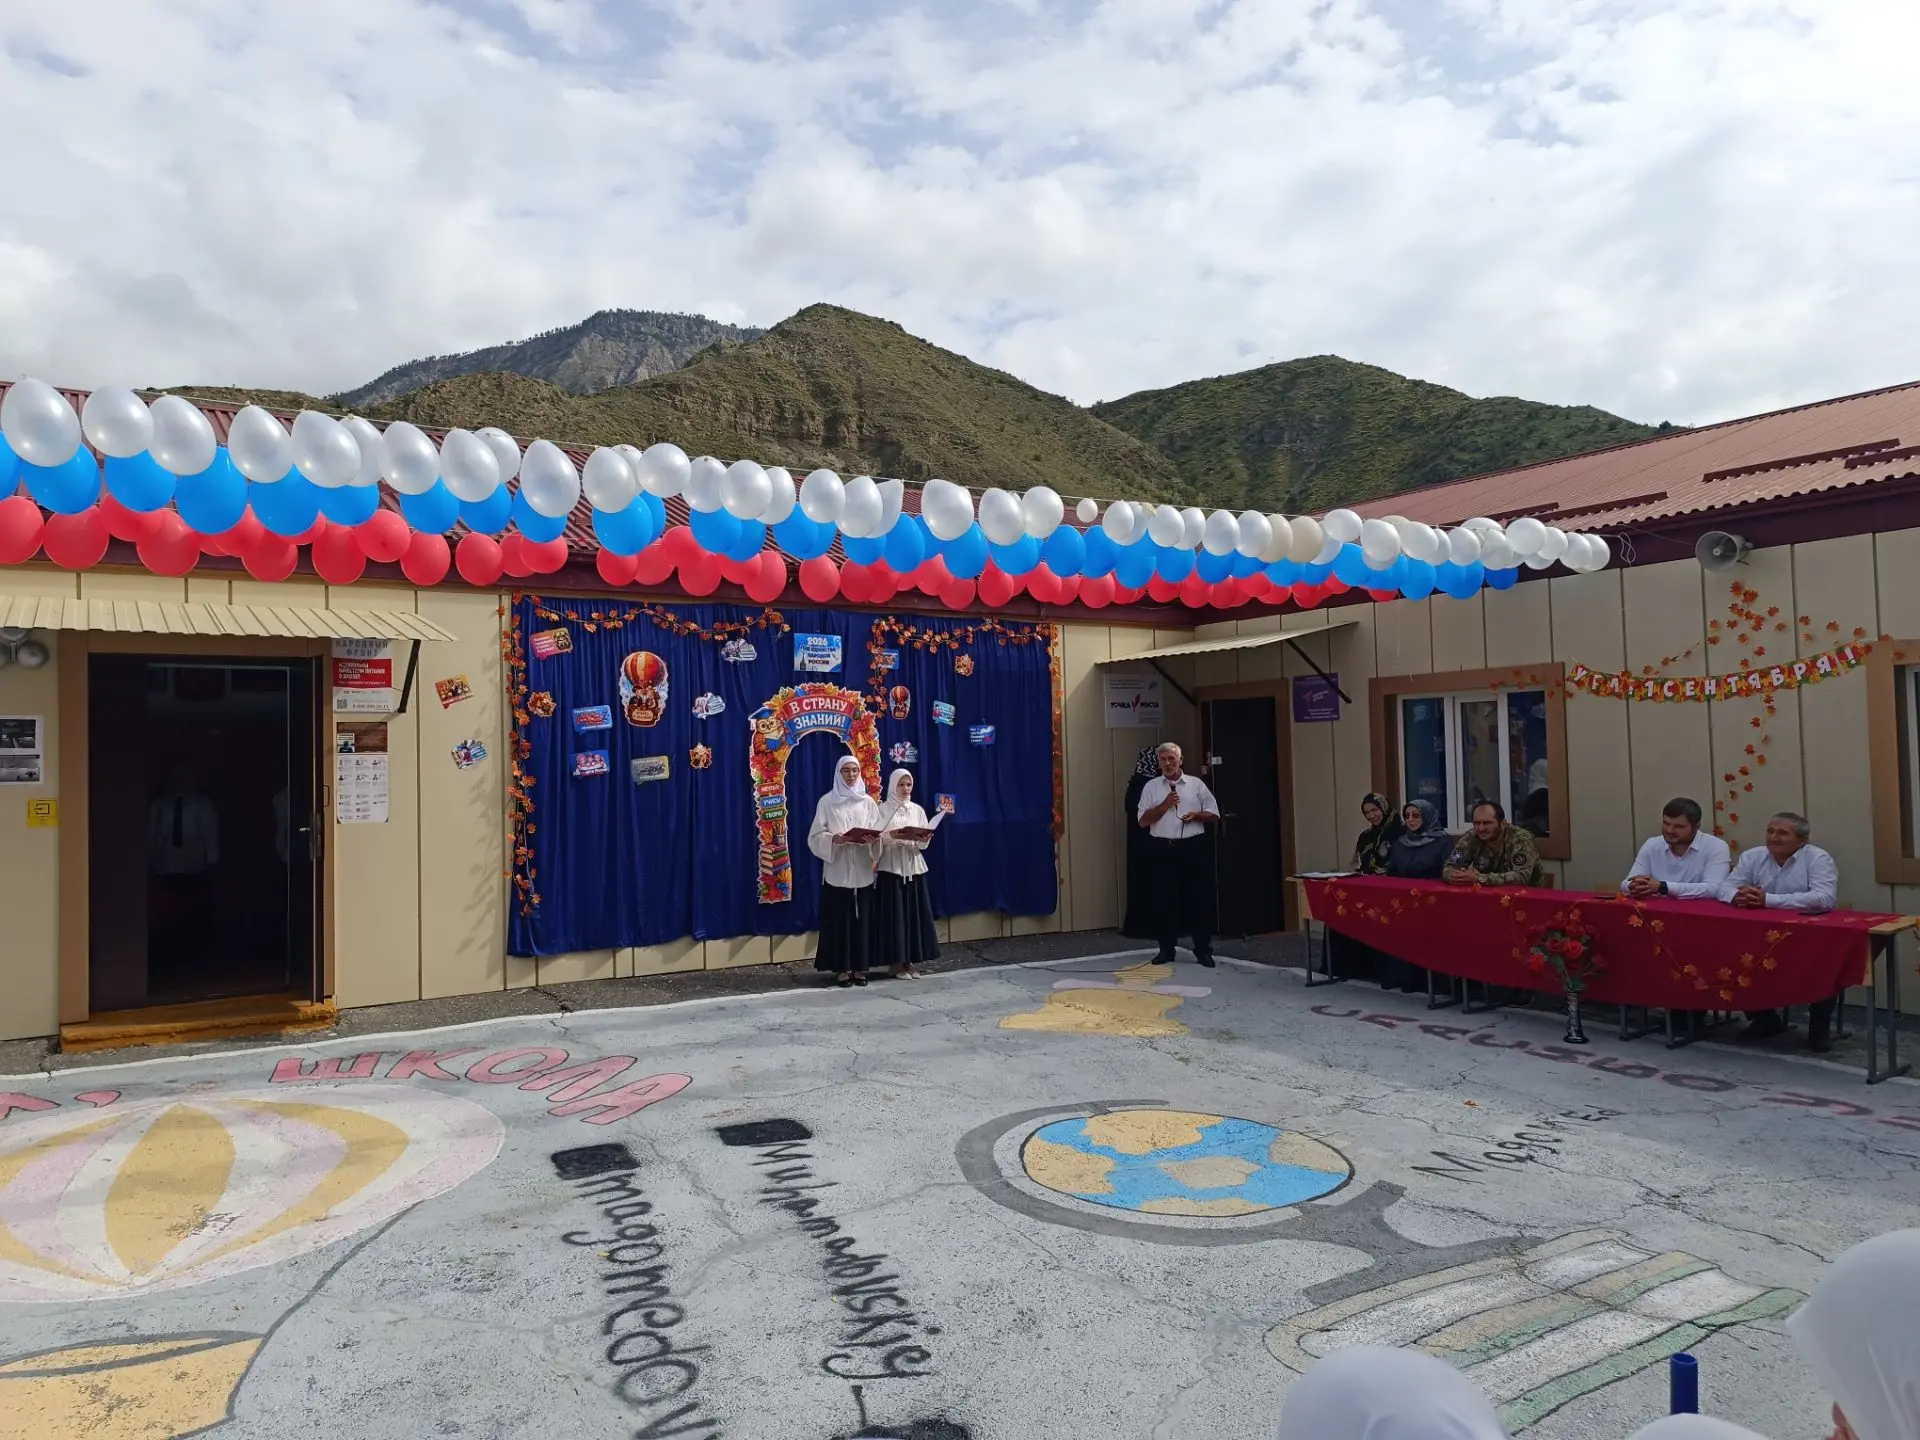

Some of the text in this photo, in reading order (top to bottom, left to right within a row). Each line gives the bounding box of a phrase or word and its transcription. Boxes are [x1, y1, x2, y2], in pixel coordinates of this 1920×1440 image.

[336, 639, 388, 648] НАРОДНЫЙ
[807, 637, 828, 646] 2026
[789, 697, 848, 714] В СТРАНУ
[793, 712, 846, 729] ЗНАНИЙ!
[268, 1046, 693, 1126] ШКОЛА
